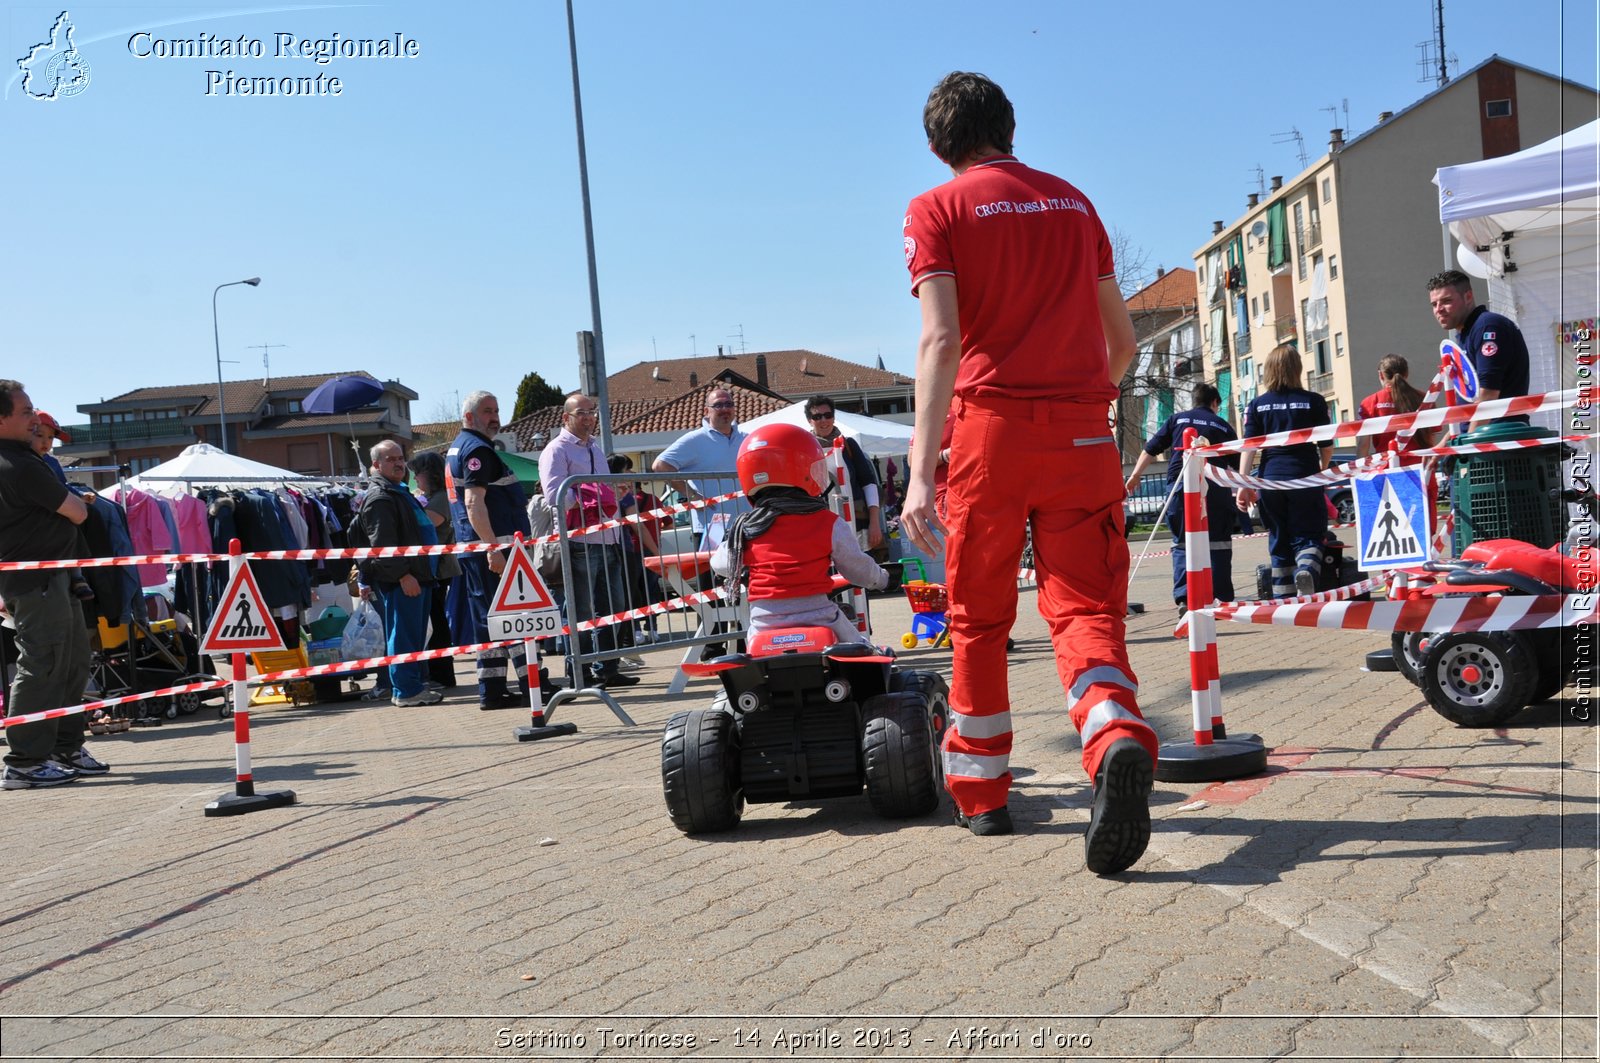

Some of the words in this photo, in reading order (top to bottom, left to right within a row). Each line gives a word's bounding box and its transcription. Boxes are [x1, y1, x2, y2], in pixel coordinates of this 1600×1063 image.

[975, 201, 1012, 217] CROCE
[1013, 200, 1048, 213] ROSSA
[502, 616, 555, 634] DOSSO
